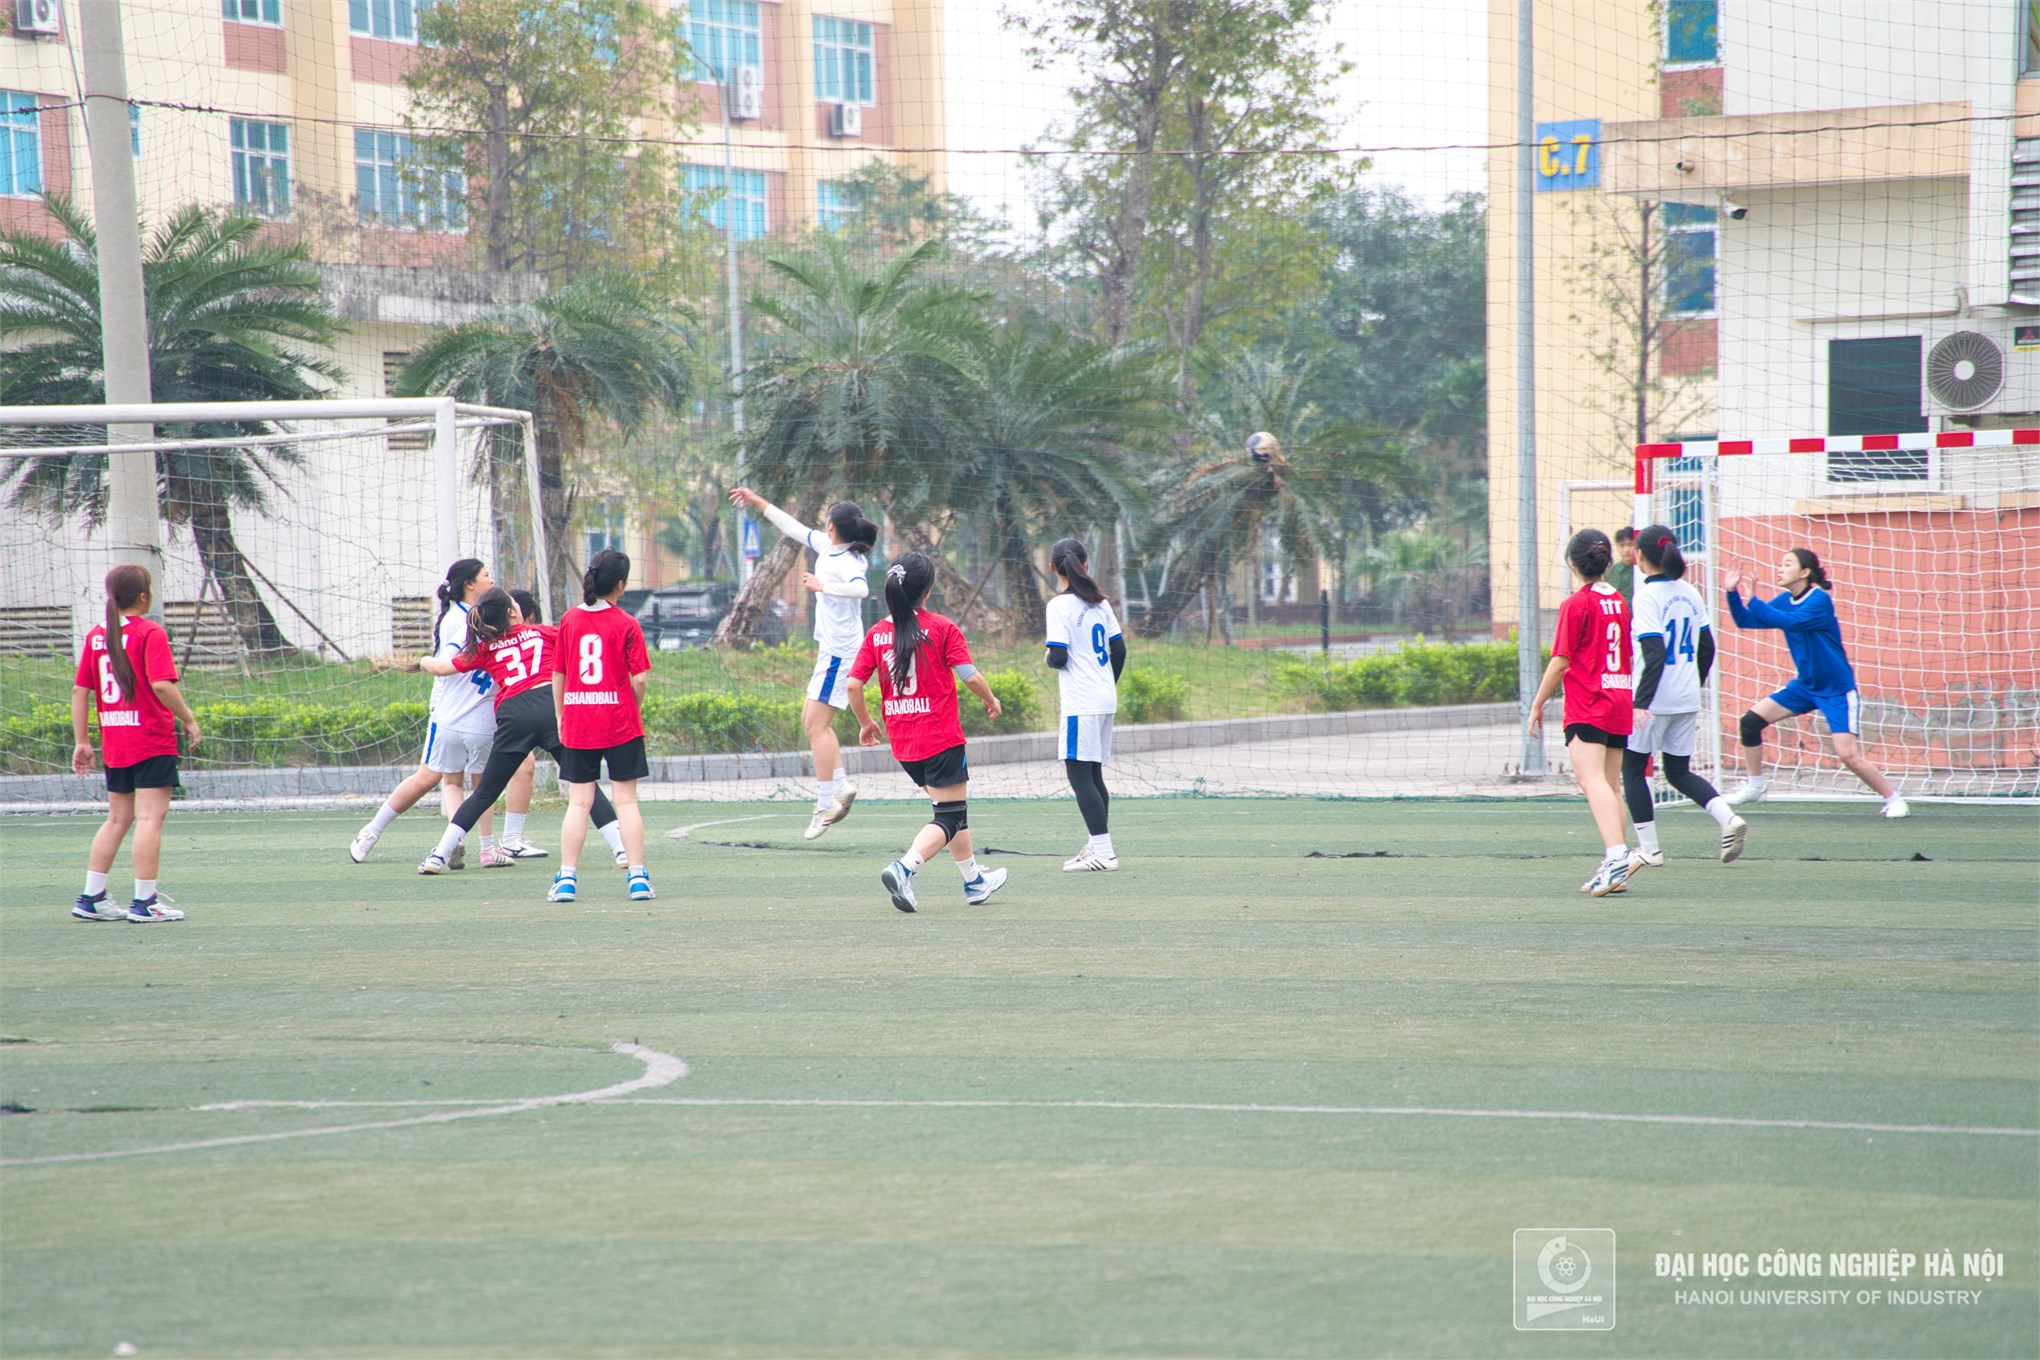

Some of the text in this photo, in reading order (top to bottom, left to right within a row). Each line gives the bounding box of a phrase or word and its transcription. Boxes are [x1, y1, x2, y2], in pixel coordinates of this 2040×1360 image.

[1540, 135, 1591, 177] C.7
[495, 637, 544, 687] 37
[579, 633, 603, 685] 8
[1092, 623, 1109, 667] 9
[1606, 622, 1621, 672] 3
[1665, 617, 1695, 666] 14
[98, 654, 122, 704] 6
